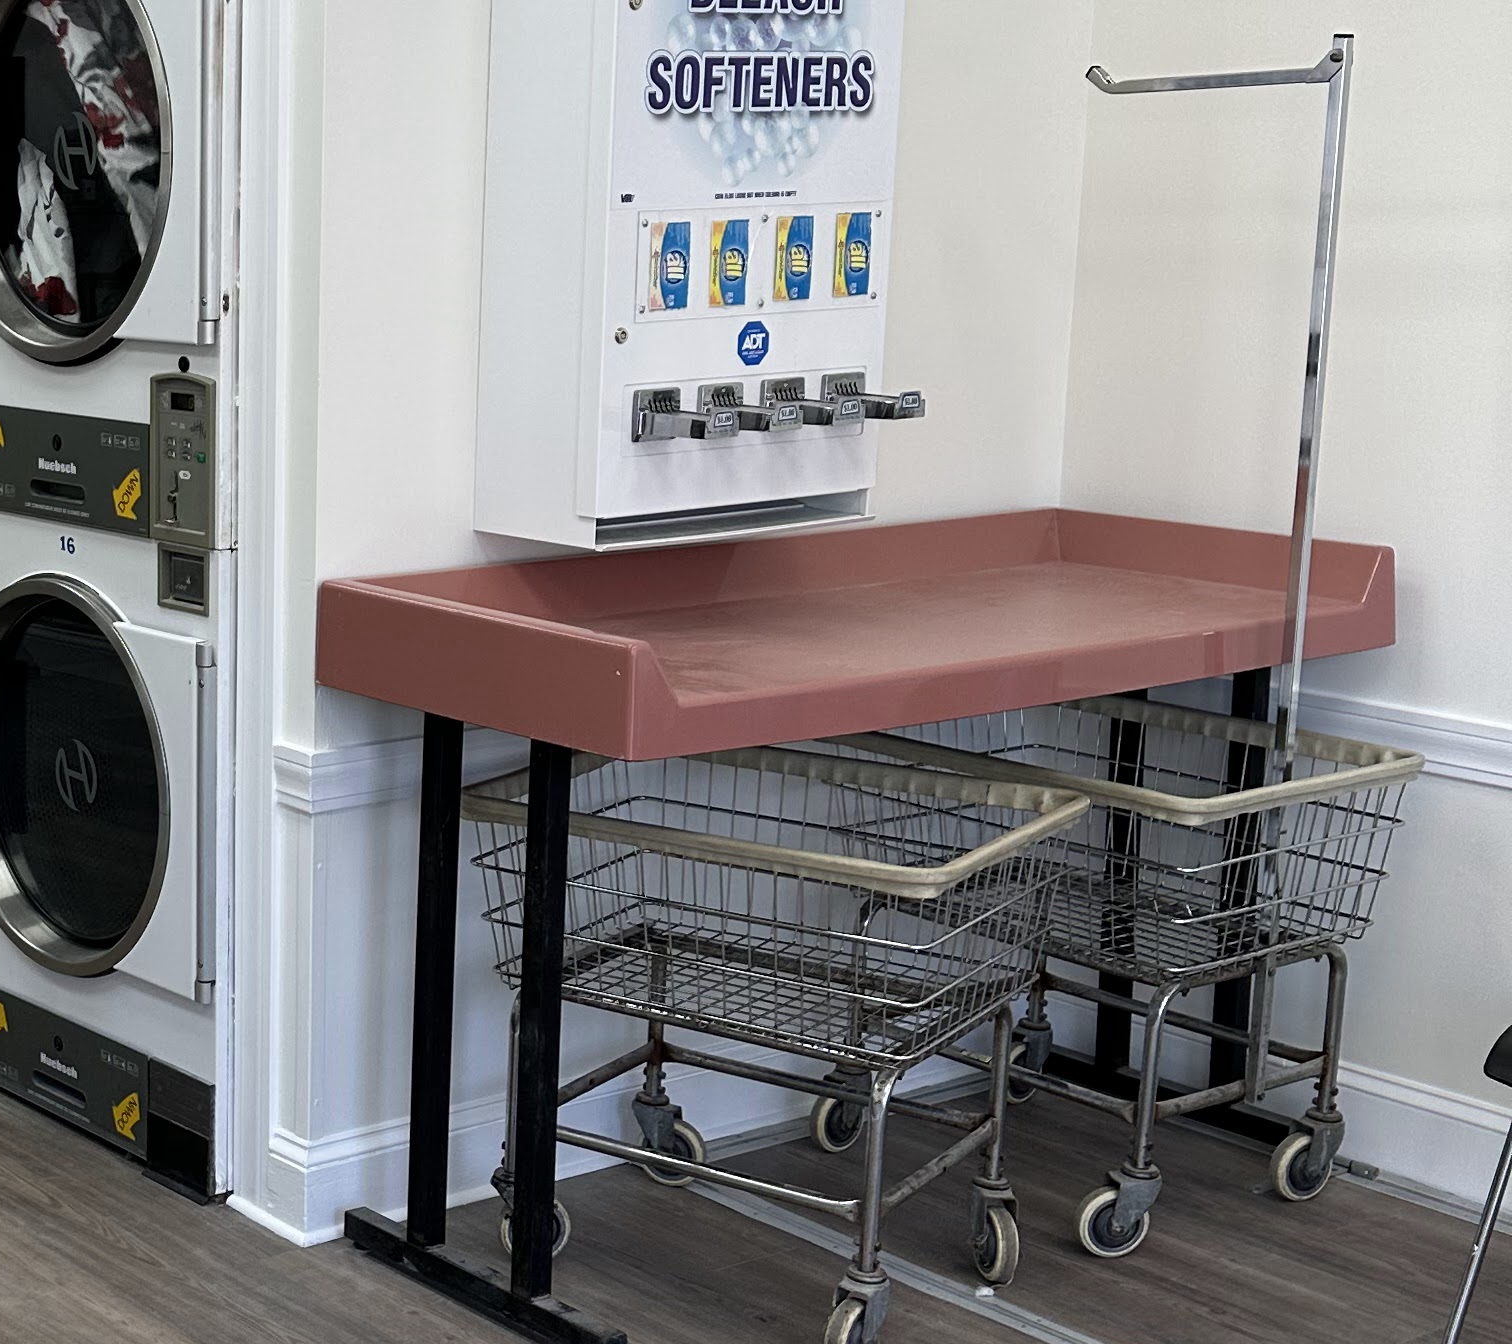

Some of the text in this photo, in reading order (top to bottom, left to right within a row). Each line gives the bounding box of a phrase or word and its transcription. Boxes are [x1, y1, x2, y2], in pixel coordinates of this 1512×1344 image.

[648, 52, 873, 113] SOFTENERS
[742, 333, 766, 350] ADT
[38, 457, 77, 475] Huebsch
[117, 475, 139, 513] DOWN
[59, 536, 75, 555] 16
[117, 1097, 138, 1131] DOWN
